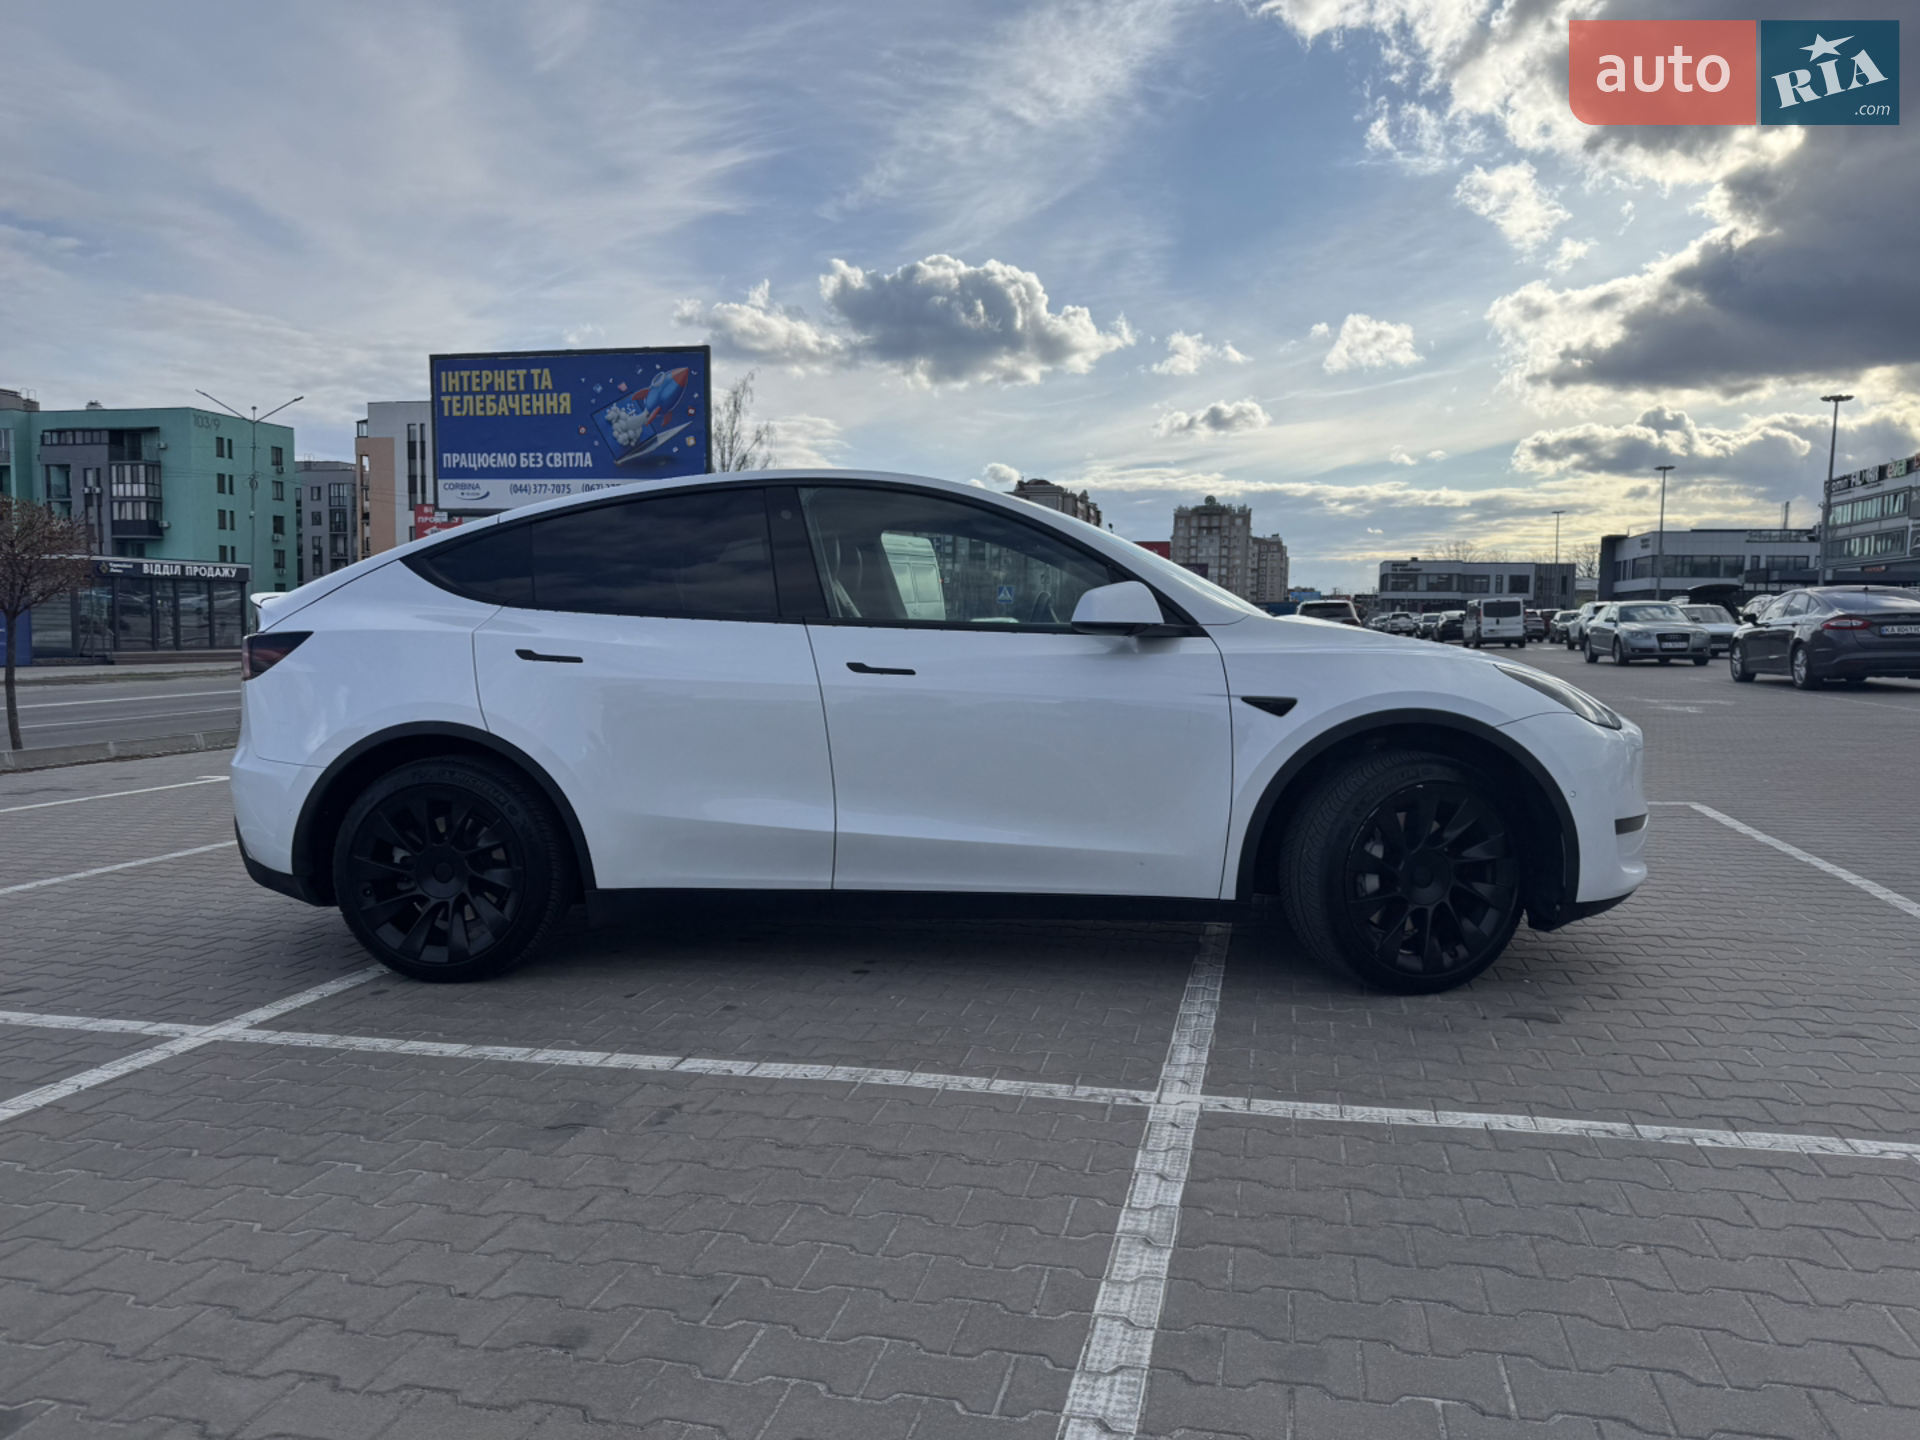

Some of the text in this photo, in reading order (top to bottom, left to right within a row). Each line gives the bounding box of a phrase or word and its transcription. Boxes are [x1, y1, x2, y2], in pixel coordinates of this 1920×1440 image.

[441, 368, 553, 393] ІНТЕРНЕТ ТА
[441, 393, 572, 417] ТЕЛЕБАЧЕННЯ
[193, 413, 221, 431] 103/9
[442, 452, 593, 471] ПРАЦЮЄМО БЕЗ СВІТЛА
[443, 482, 481, 491] CORBINA
[142, 563, 181, 576] ВІДДІЛ
[185, 565, 237, 578] ПРОДАЖУ
